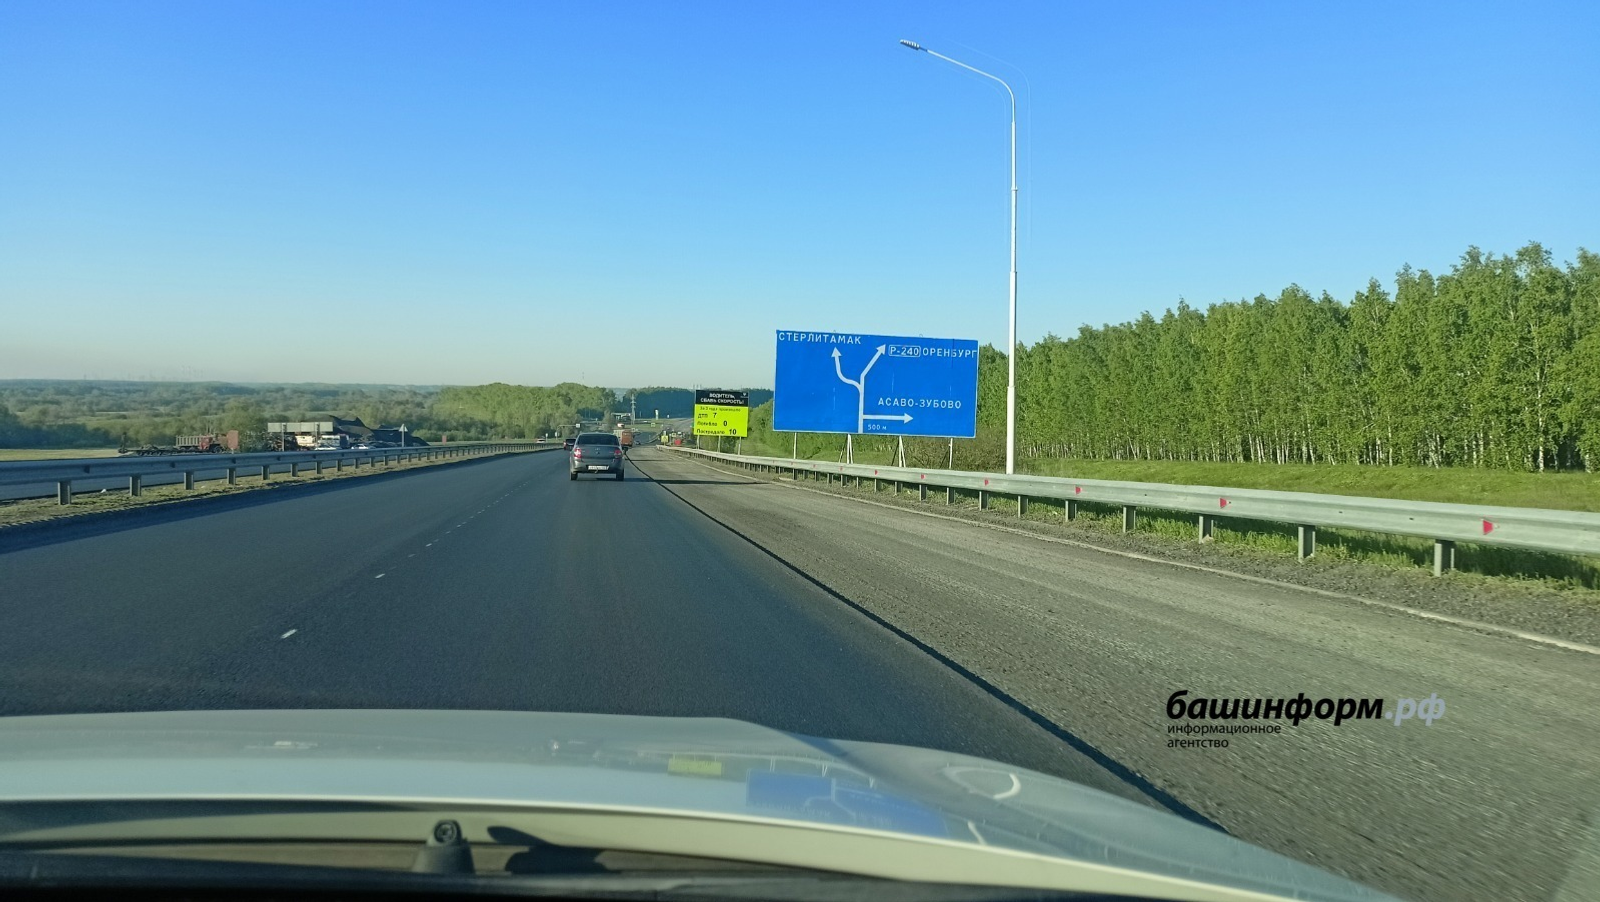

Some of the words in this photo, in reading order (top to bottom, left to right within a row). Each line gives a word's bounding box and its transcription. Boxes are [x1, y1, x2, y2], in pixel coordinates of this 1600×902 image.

[778, 332, 862, 345] СТЕРЛИТАМАК
[922, 348, 978, 358] ОРЕНБУРГ
[878, 397, 962, 409] АСАВО-ЗУБОВО
